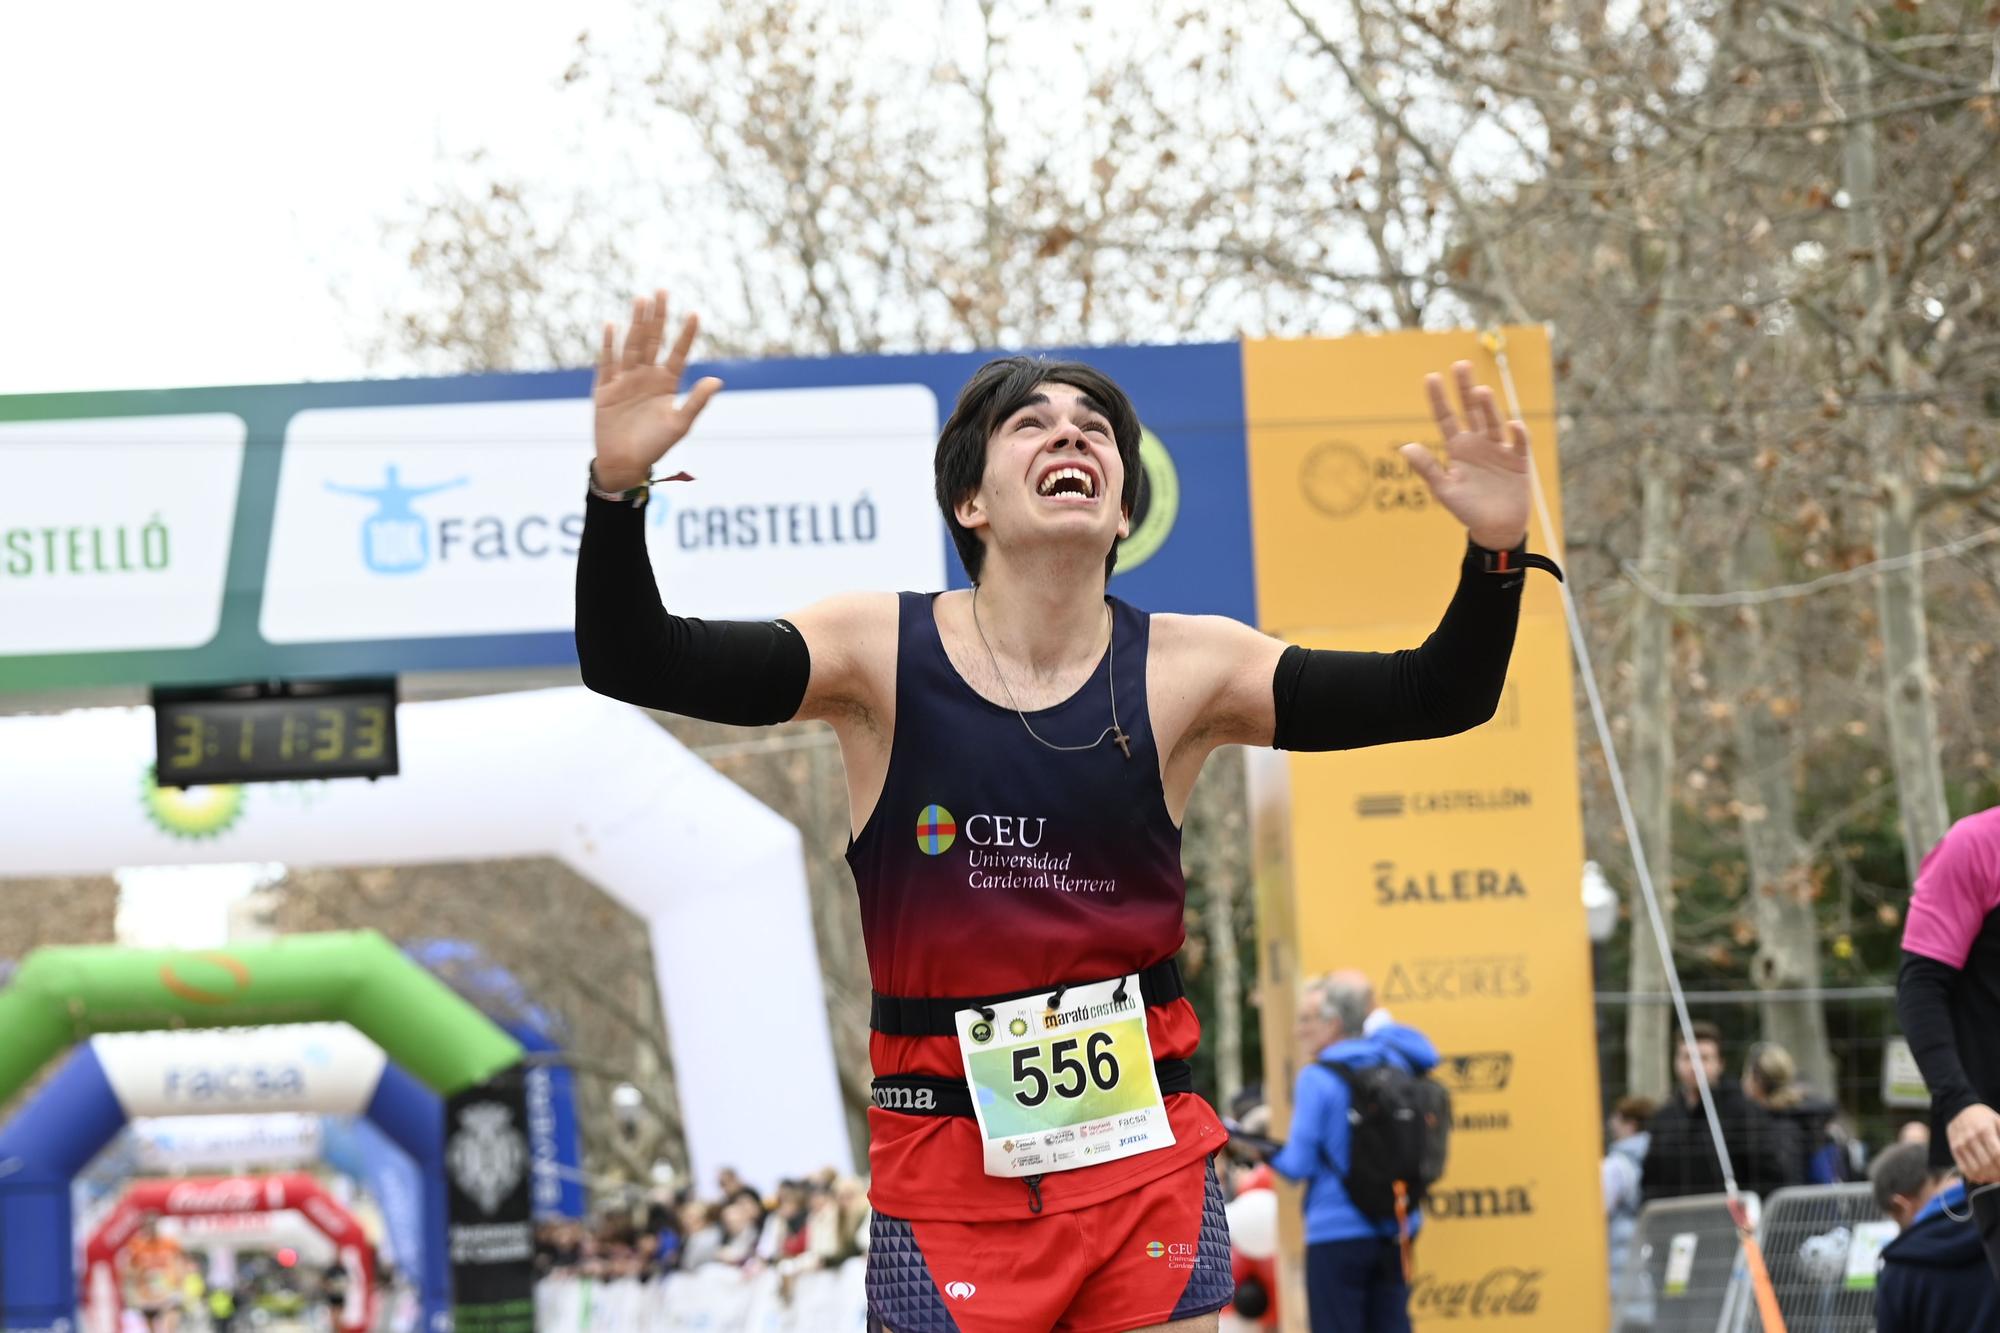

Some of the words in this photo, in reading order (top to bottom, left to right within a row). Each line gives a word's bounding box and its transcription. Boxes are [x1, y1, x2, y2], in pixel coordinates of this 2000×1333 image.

[438, 514, 586, 560] Facs
[677, 489, 877, 550] CASTELLÓ
[0, 509, 169, 576] STELLÓ
[170, 706, 388, 768] 3:11:33
[965, 814, 1047, 848] CEU
[969, 850, 1072, 871] Universidad
[968, 870, 1049, 889] Cardenal
[1053, 874, 1115, 893] Herrera
[1375, 868, 1528, 906] SALERA
[1044, 1006, 1089, 1029] marató
[1012, 1032, 1120, 1107] 556
[1424, 1186, 1534, 1221] oma
[1167, 1243, 1193, 1255] CEU
